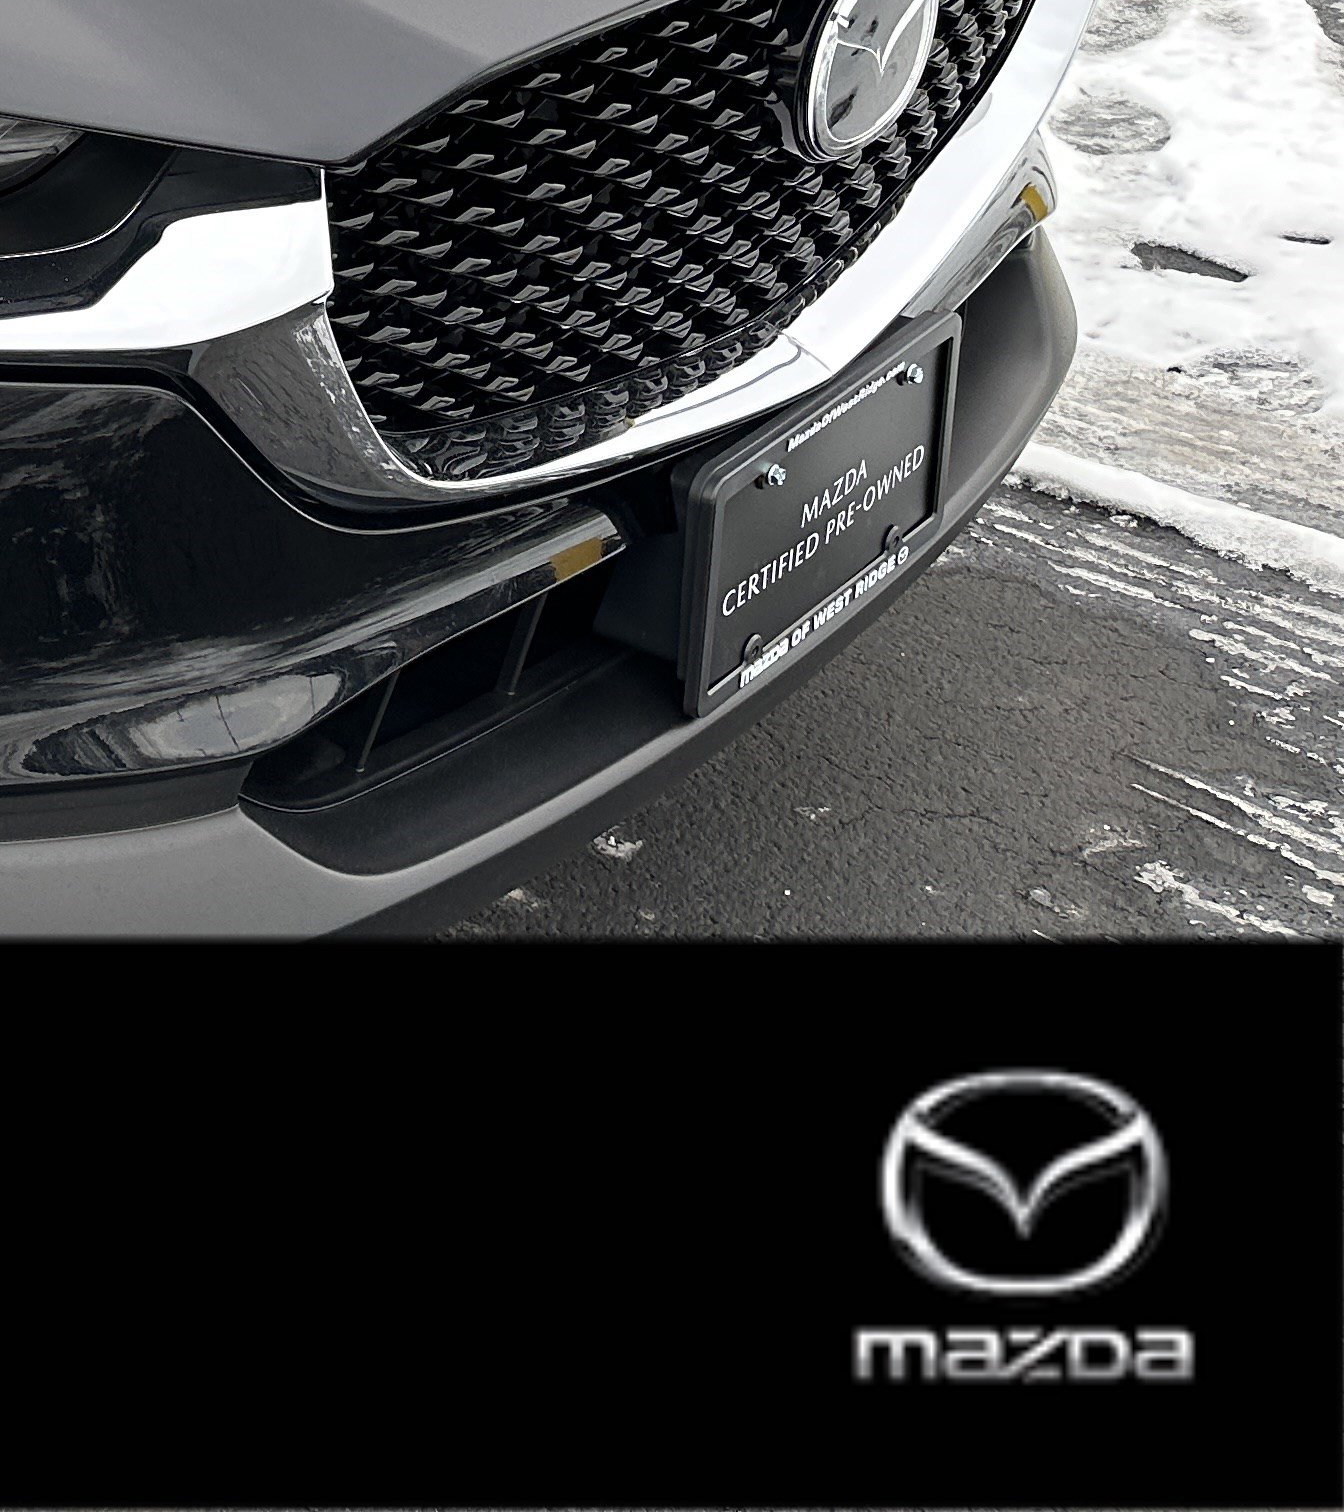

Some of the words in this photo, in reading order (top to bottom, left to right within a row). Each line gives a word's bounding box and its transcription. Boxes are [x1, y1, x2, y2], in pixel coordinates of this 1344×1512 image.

[722, 532, 819, 617] CERTIFIED
[824, 444, 925, 545] PRE-OWNED
[801, 459, 868, 528] MAZDA
[791, 620, 811, 648] OF
[813, 588, 853, 630] WEST
[855, 554, 897, 599] RIDGE
